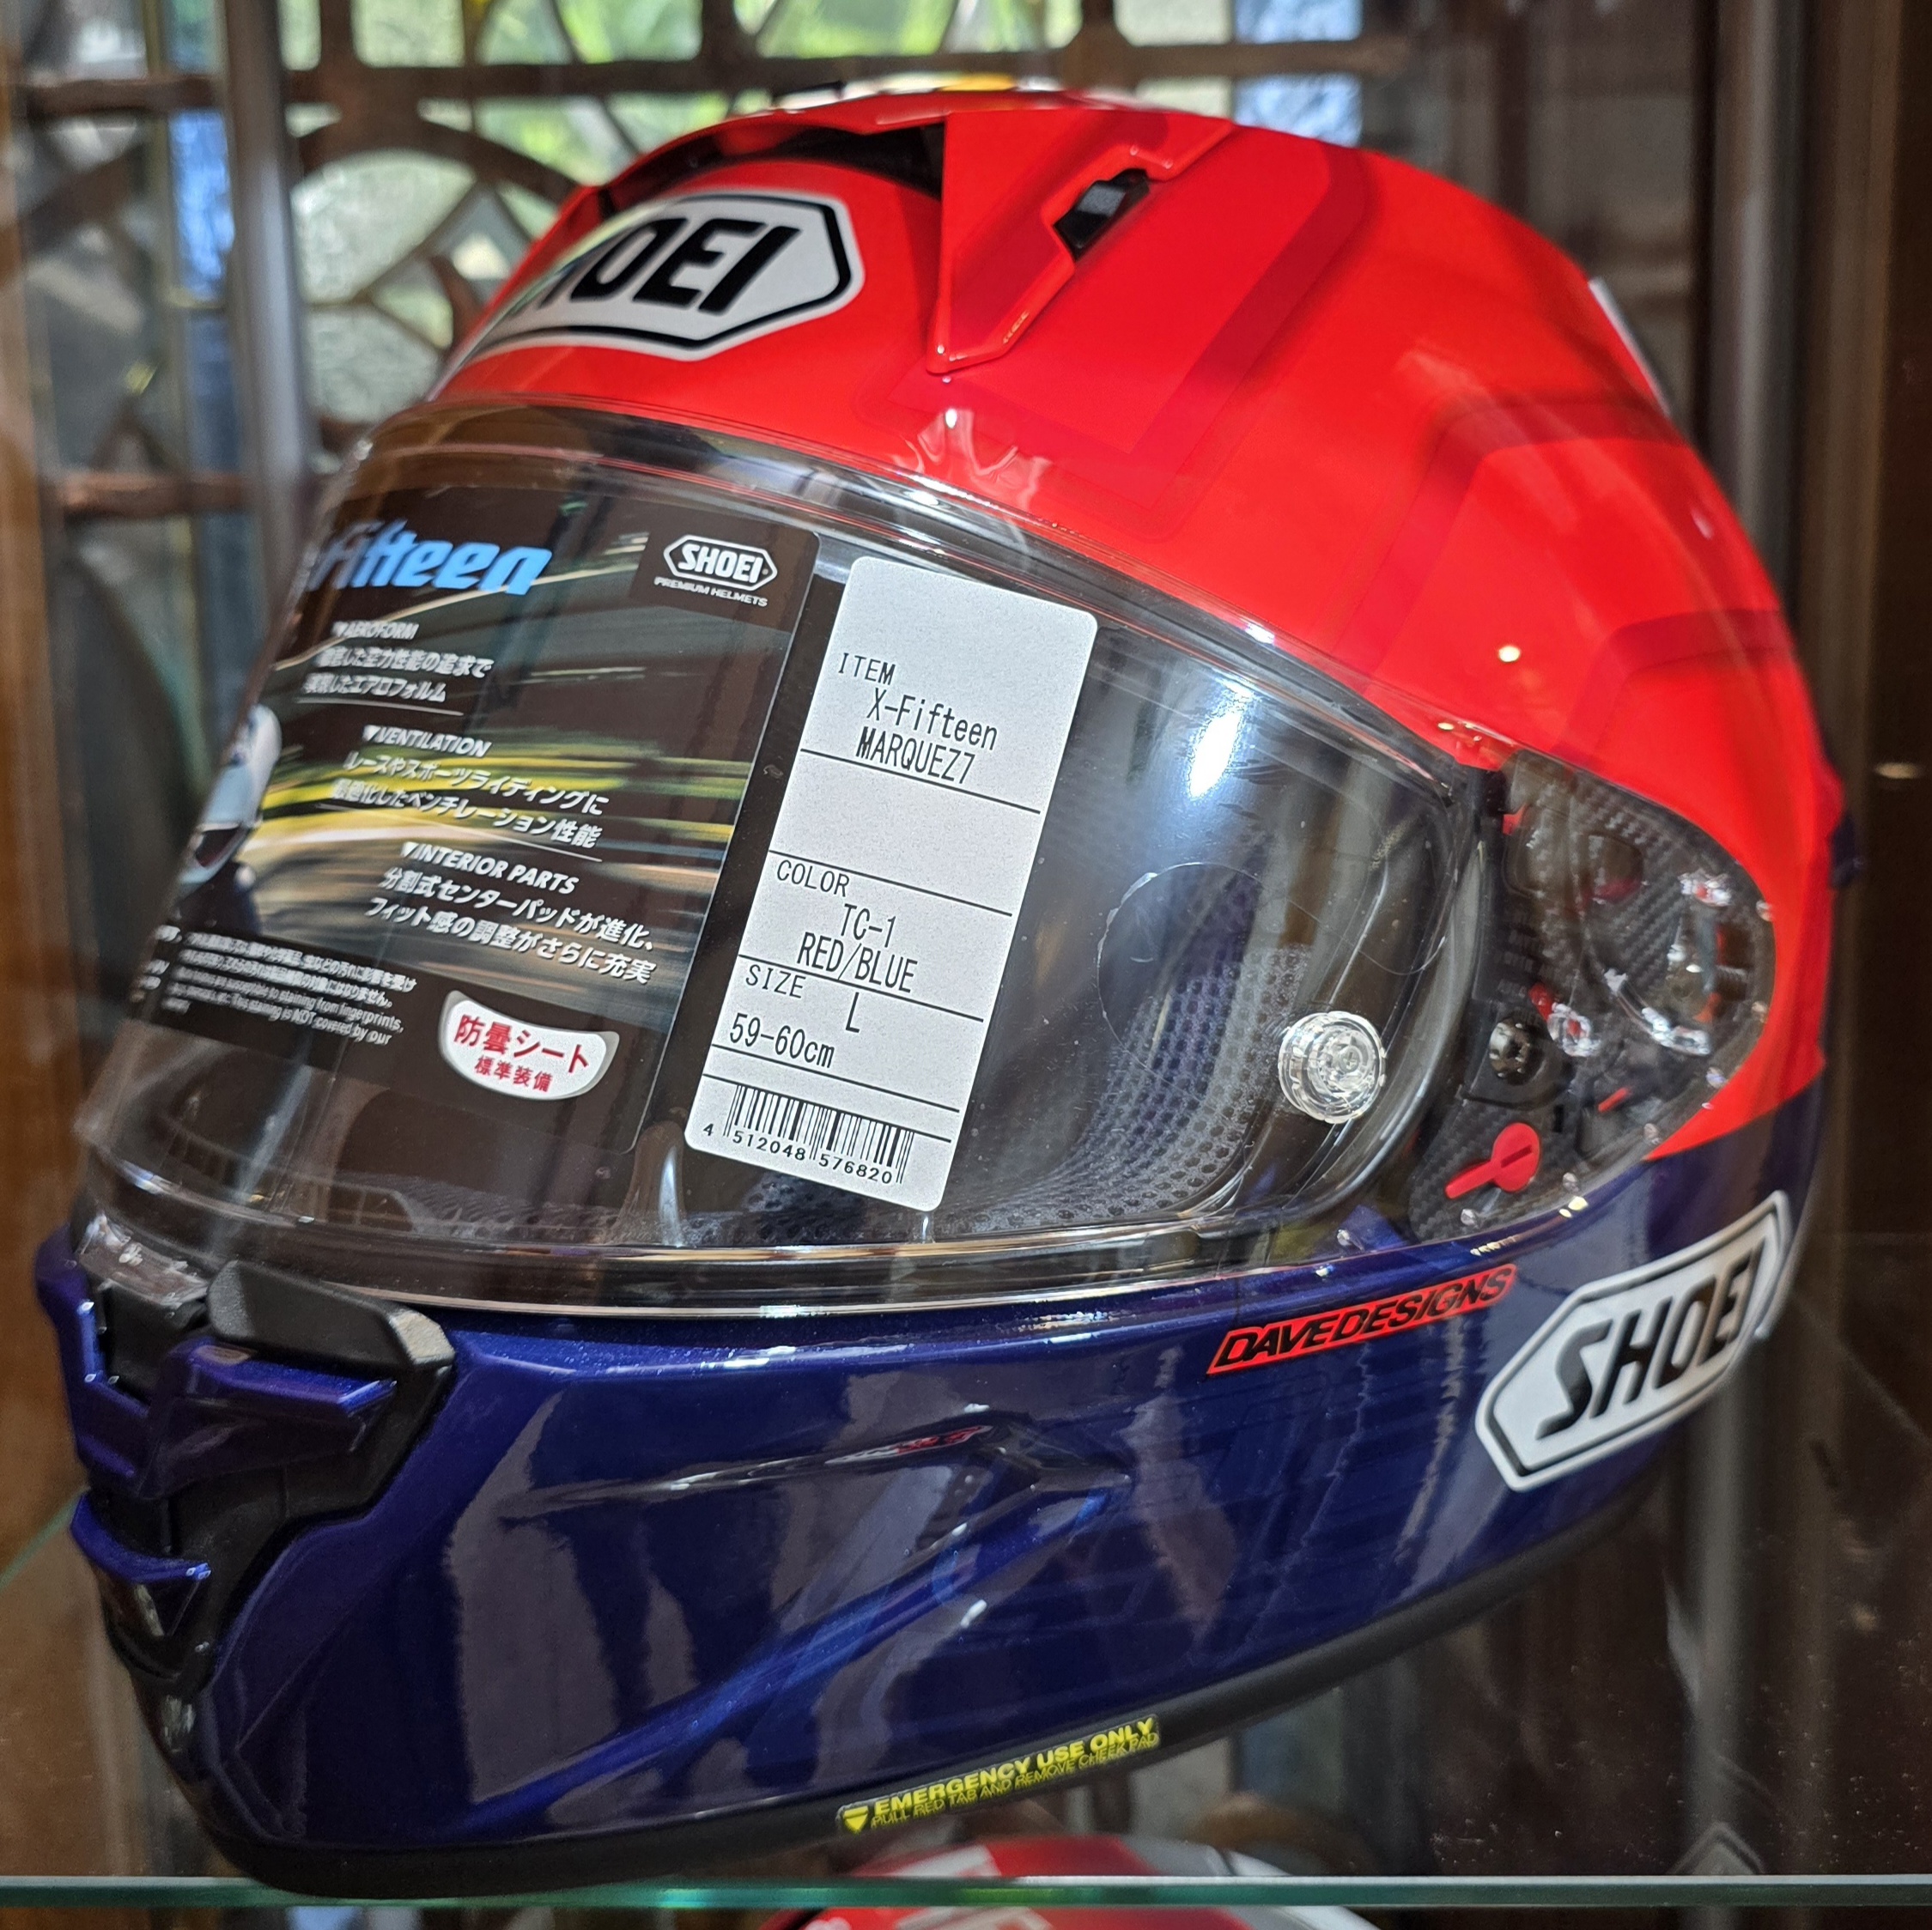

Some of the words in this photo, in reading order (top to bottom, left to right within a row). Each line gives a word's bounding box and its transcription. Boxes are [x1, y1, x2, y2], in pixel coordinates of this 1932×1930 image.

[538, 216, 802, 316] OEI
[677, 543, 763, 584] SHOEI
[653, 576, 710, 594] PREMIUM
[711, 587, 768, 607] HELMETS
[838, 652, 896, 685] ITEM
[377, 726, 492, 758] VENTILATION
[866, 687, 998, 750] X-Fifteen
[855, 726, 975, 784] MARQUEZ7
[414, 844, 509, 882] INTERIOR
[507, 864, 580, 895] PARTS
[776, 859, 850, 897] COLOR
[364, 897, 657, 985] フィット感の調整がさらに充実
[840, 903, 896, 948] TC-1
[745, 964, 806, 998] SIZE
[797, 931, 918, 993] RED/BLUE
[349, 1023, 369, 1042] by
[366, 1030, 392, 1046] our
[845, 992, 860, 1033] L
[453, 1013, 590, 1073] 防曇シート
[729, 1012, 835, 1068] 59-60cm
[474, 1055, 554, 1093] 標準装備
[702, 1123, 714, 1137] 4
[732, 1130, 806, 1161] 512048
[818, 1153, 893, 1185] 576820
[1213, 1268, 1514, 1368] DAVEDESIGNS
[873, 1757, 1030, 1817] EMERGENCY
[1036, 1739, 1084, 1770] USE
[1089, 1716, 1155, 1754] ONLY
[914, 1798, 945, 1818] RED
[949, 1789, 977, 1808] TAB
[980, 1778, 1012, 1800] AND
[1015, 1759, 1076, 1787] REMOVE
[1128, 1732, 1160, 1754] PAD
